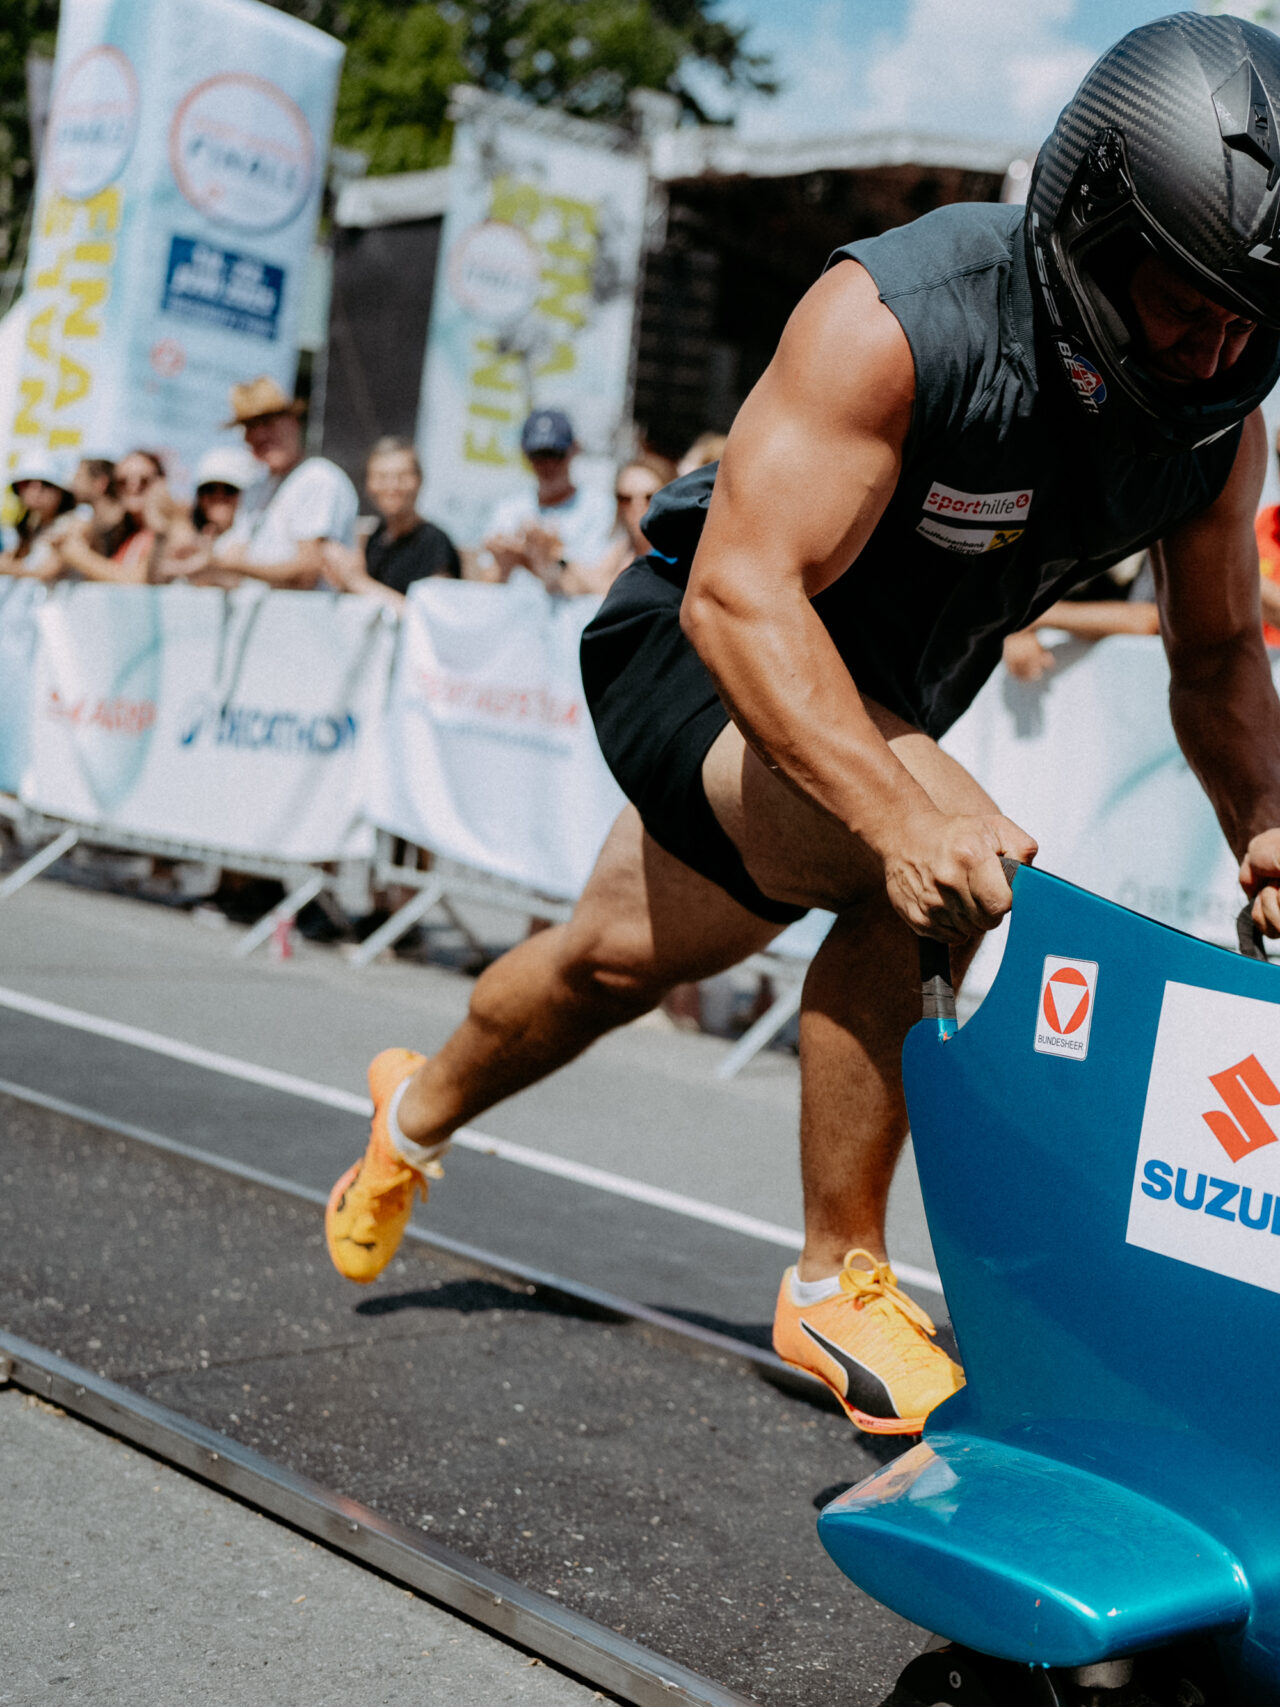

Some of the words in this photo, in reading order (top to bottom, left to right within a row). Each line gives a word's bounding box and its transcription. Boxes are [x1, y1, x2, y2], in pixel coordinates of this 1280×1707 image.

[1058, 341, 1079, 371] BE
[1072, 377, 1099, 414] FIT!
[928, 492, 1016, 515] sporthilfe
[1037, 1034, 1084, 1051] BUNDESHEER
